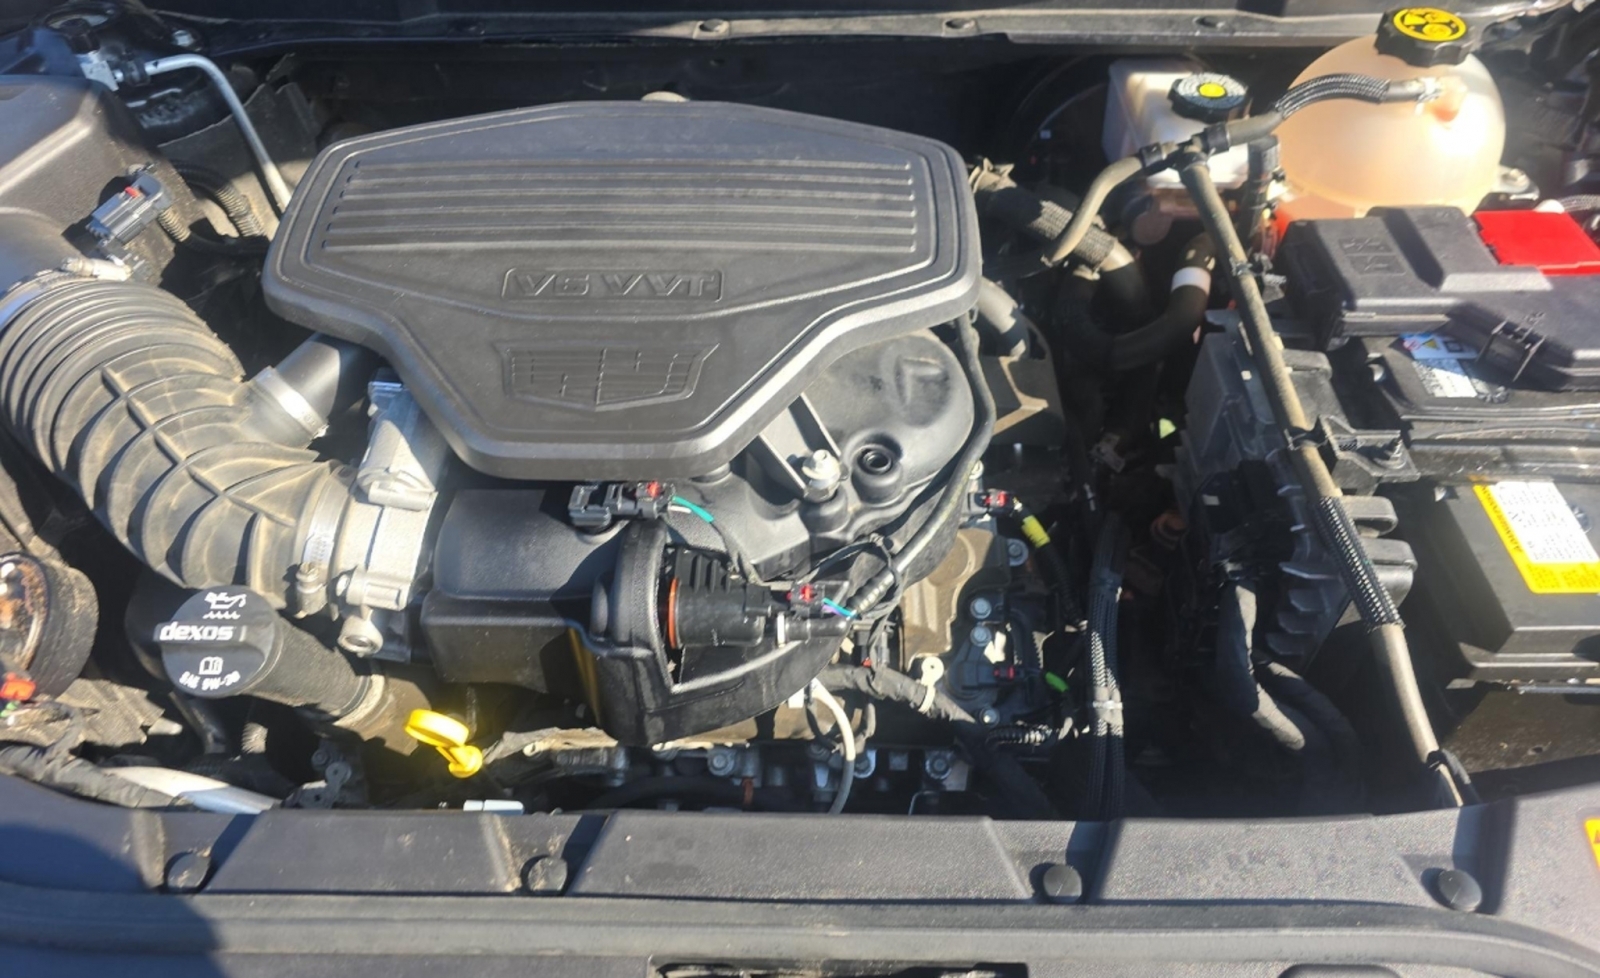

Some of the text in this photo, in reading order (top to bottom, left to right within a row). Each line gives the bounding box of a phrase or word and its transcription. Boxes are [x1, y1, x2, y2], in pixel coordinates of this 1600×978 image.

[514, 273, 715, 296] V6 VVT
[159, 621, 234, 641] dexos
